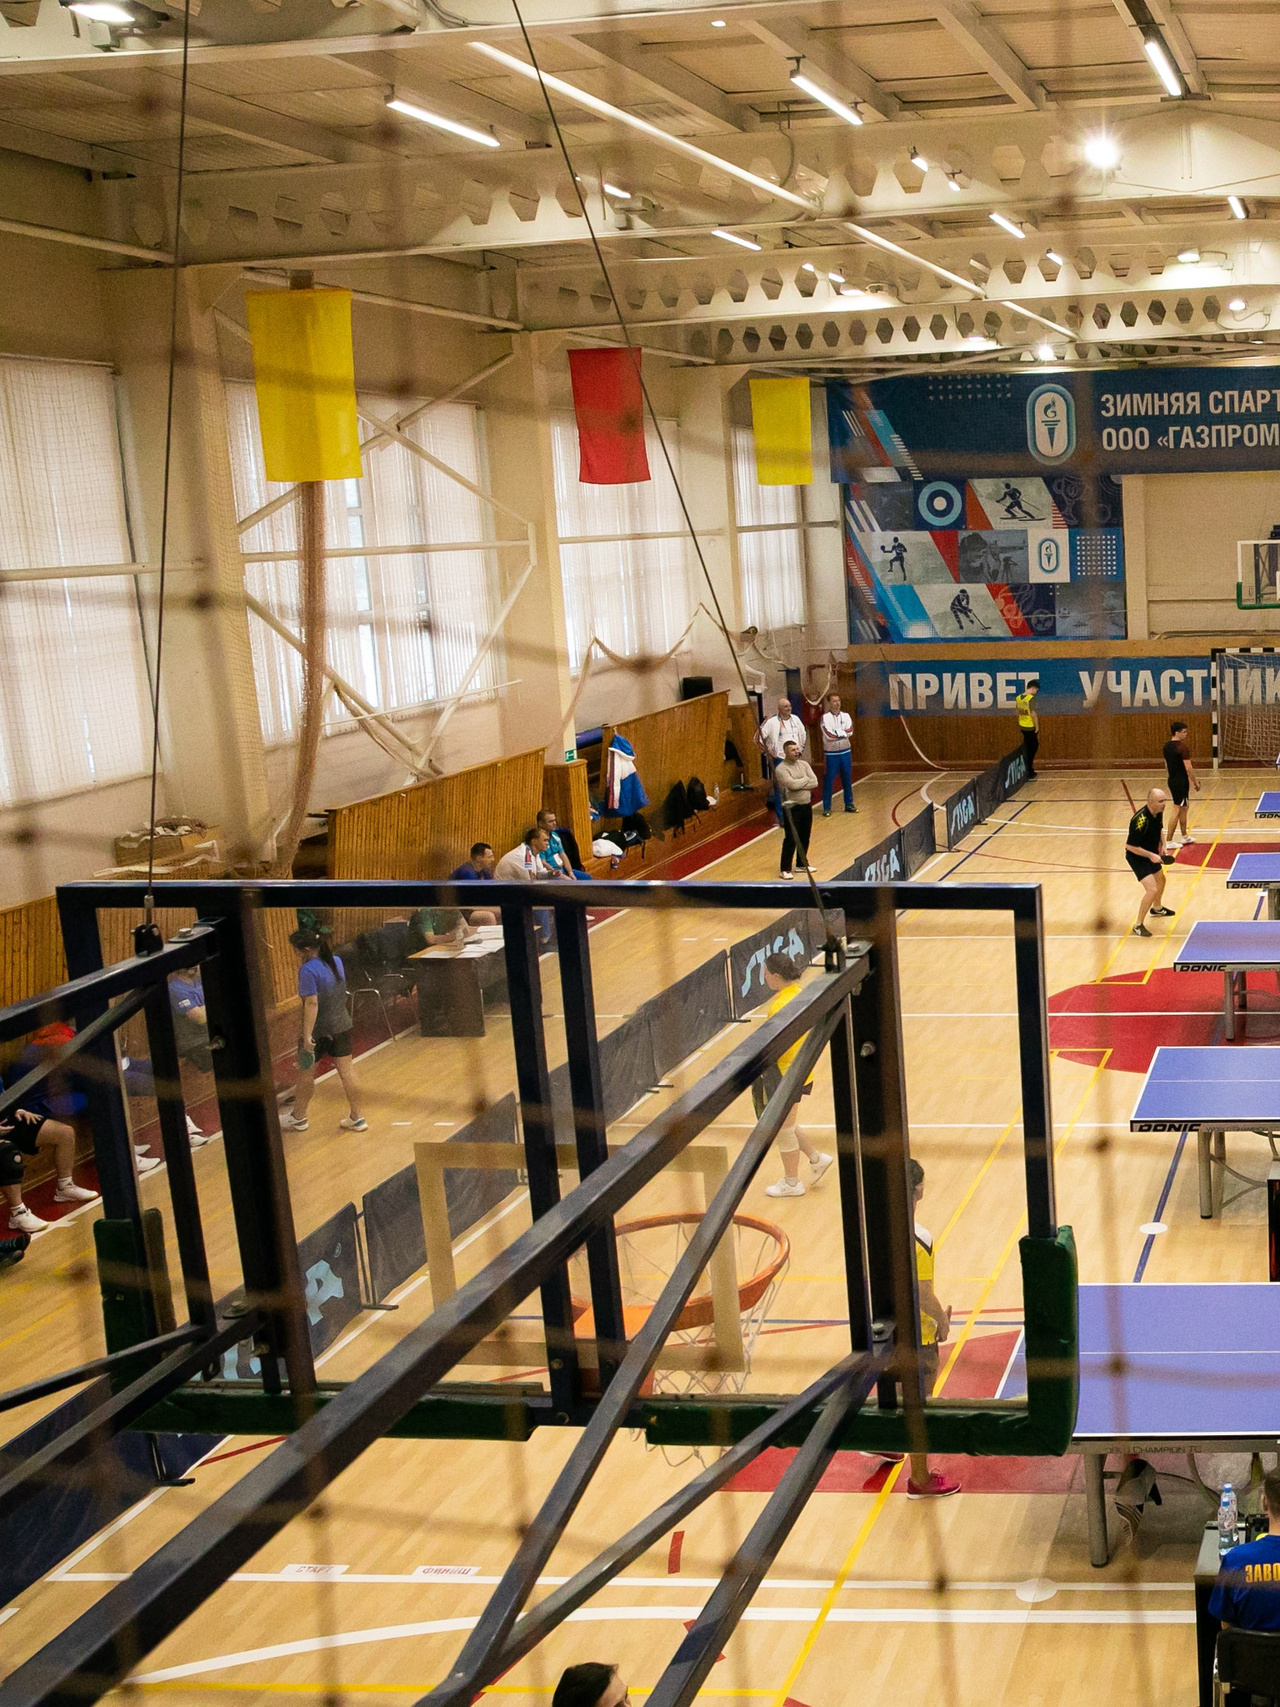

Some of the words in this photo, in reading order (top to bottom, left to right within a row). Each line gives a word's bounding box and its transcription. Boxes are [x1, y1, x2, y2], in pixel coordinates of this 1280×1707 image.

[1101, 391, 1200, 417] ЗИМНЯЯ
[1102, 427, 1149, 451] ООО
[1157, 423, 1279, 449] «ГАЗПРОМ
[1004, 754, 1026, 789] STIGA
[951, 793, 975, 836] STIGA
[1180, 964, 1227, 972] DONIC
[1138, 1123, 1201, 1132] DONIC
[1133, 1446, 1185, 1454] CHAMPION
[296, 1565, 334, 1573] СТАРТ
[422, 1566, 472, 1575] ФИНИШ
